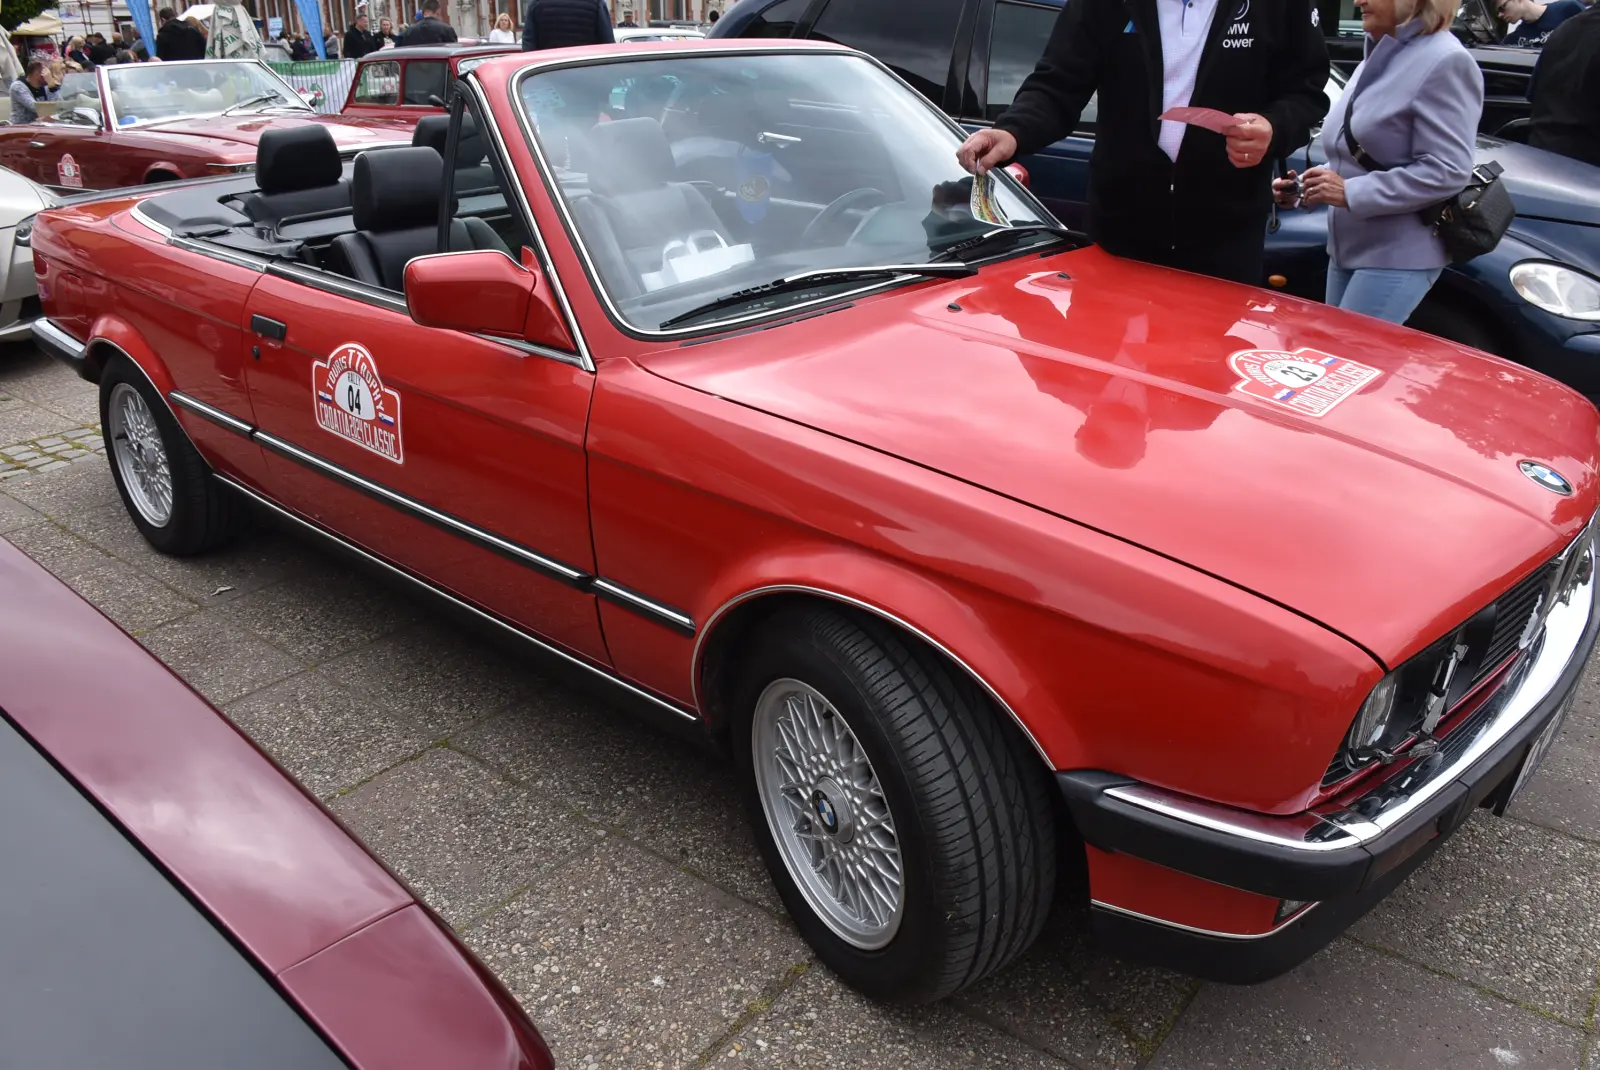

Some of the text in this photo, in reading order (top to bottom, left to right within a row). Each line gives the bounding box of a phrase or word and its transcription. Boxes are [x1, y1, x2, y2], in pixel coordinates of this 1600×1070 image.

[1228, 22, 1250, 35] MW
[1222, 38, 1254, 48] ower
[326, 349, 385, 411] TOURIST TROPHY
[1281, 366, 1318, 382] 23
[348, 385, 361, 415] 04
[319, 402, 351, 438] CROATIA
[364, 422, 398, 459] CLASSIC
